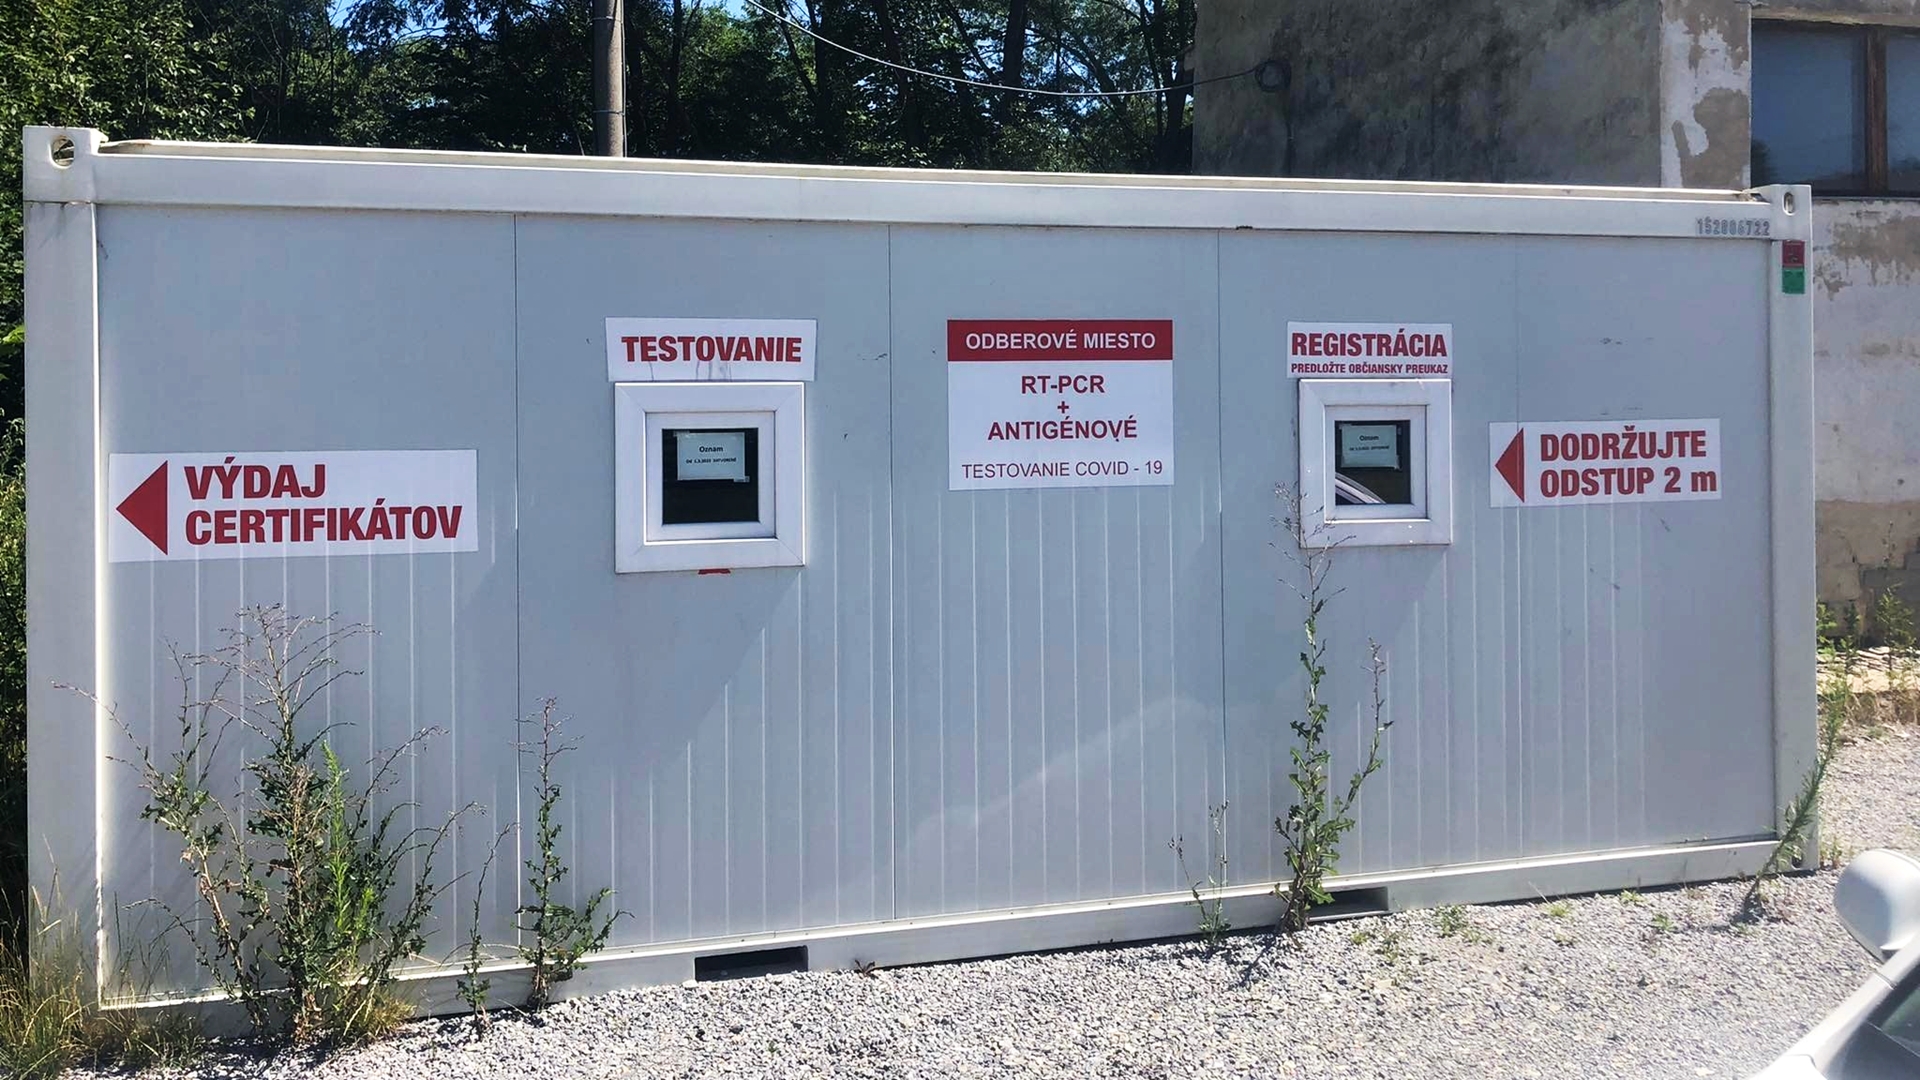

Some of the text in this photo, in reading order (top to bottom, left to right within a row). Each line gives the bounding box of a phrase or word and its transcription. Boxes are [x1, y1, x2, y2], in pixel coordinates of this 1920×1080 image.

[621, 336, 802, 362] TESTOVANIE
[965, 329, 1156, 350] ODBEROVÉ MIESTO
[1291, 328, 1448, 357] REGISTRÁCIA
[1291, 361, 1448, 374] PREDLOŽTE OBČIANSKY PREUKAZ
[1021, 375, 1105, 394] RT-PCR
[1057, 401, 1070, 414] +
[987, 415, 1138, 441] ANTIGÉNOVÉ
[1540, 425, 1707, 462] DODRŽUJTE
[183, 456, 326, 500] VÝDAJ
[962, 462, 1070, 479] TESTOVANIE
[1075, 460, 1129, 476] COVID
[1146, 460, 1163, 475] 19
[1540, 467, 1717, 498] ODSTUP 2 m
[185, 497, 463, 545] CERTIFIKÁTOV
